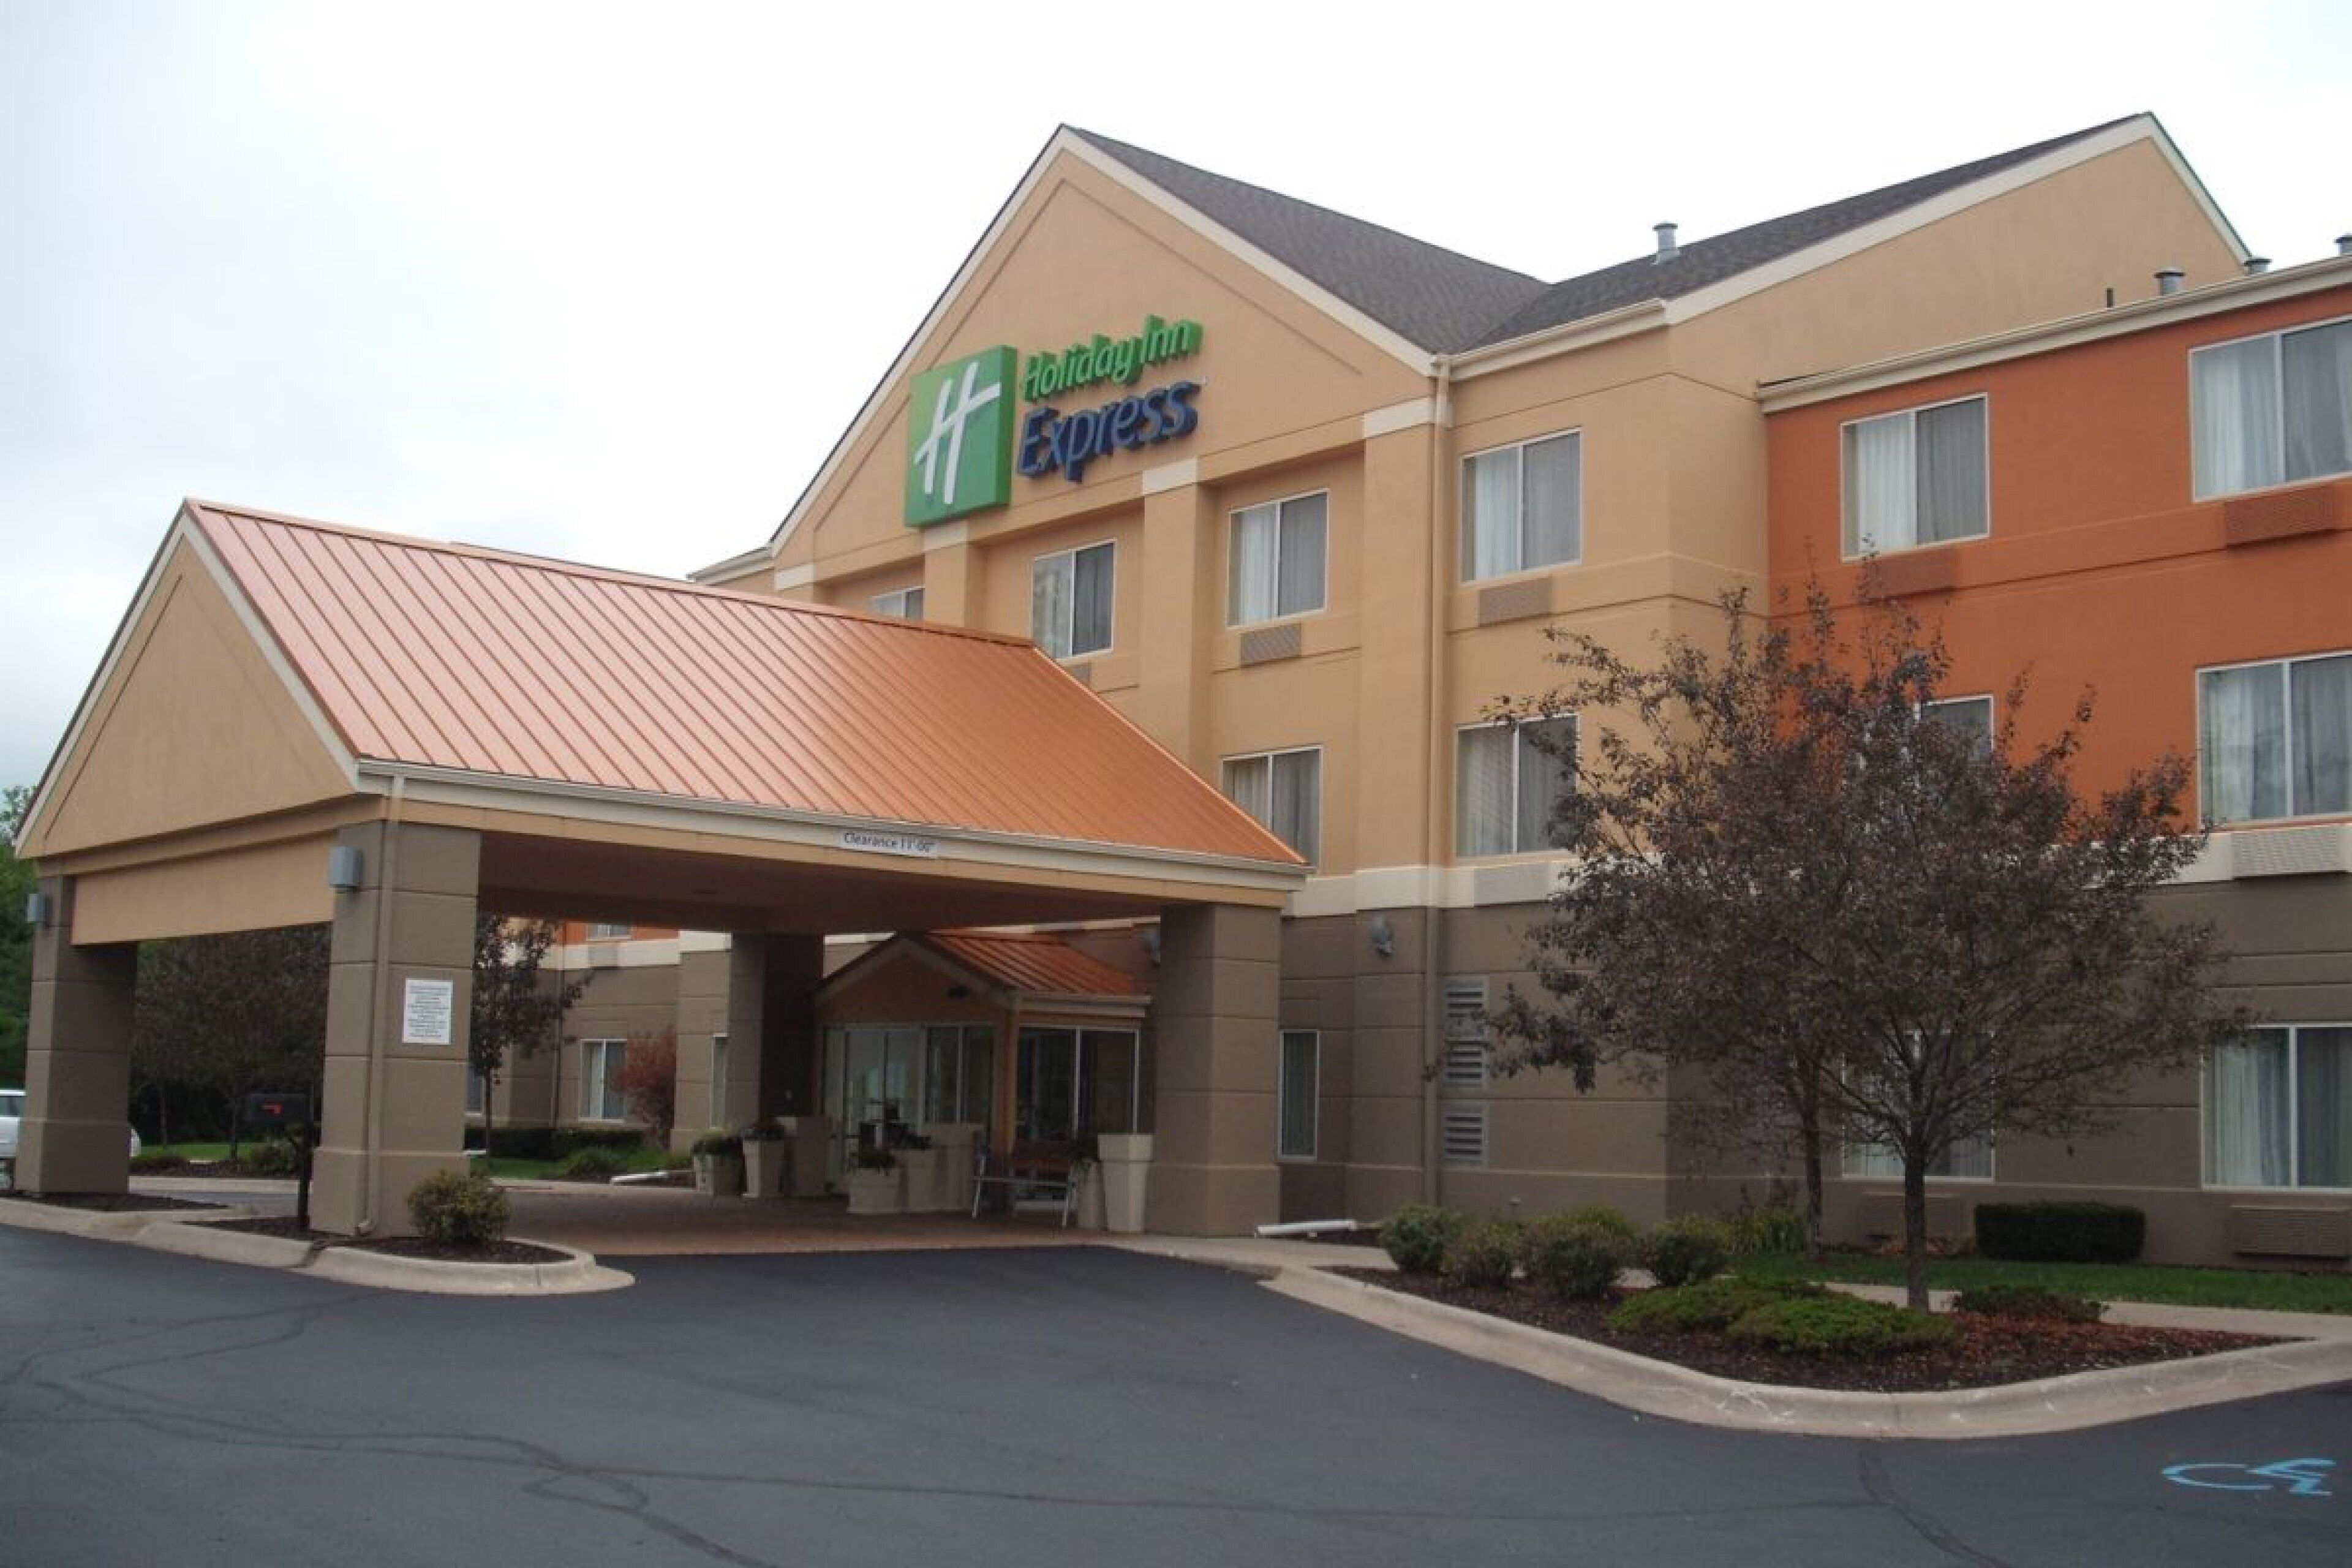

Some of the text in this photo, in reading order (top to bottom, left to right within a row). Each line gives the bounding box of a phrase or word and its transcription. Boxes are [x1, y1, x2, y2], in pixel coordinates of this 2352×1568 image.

[1023, 315, 1202, 401] Holiday Inn
[1017, 381, 1201, 483] Express
[844, 832, 898, 848] Clearance
